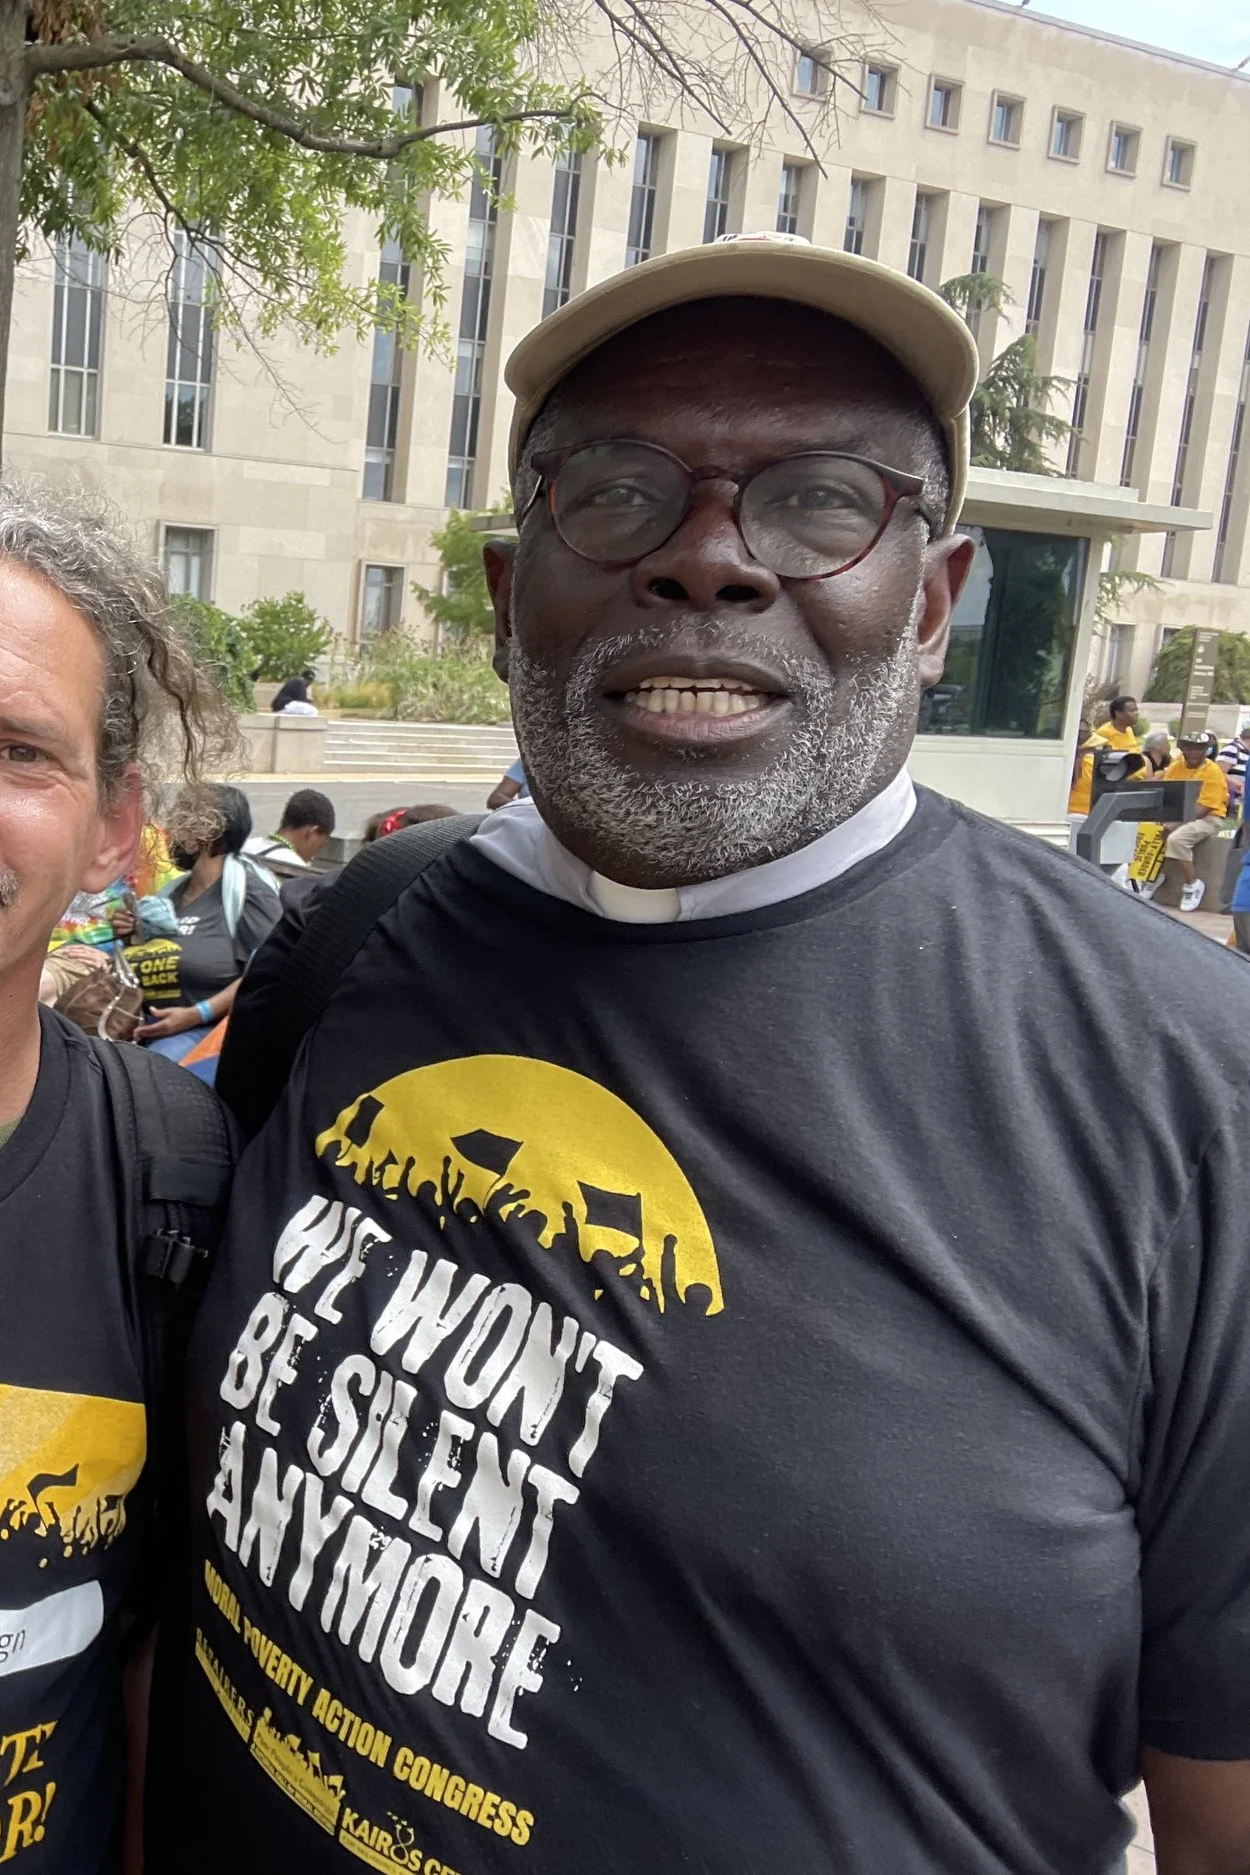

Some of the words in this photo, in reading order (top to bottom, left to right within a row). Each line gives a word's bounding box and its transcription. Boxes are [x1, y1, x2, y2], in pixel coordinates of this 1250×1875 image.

[140, 956, 181, 974] ONE
[220, 1291, 318, 1436] BE
[307, 1354, 581, 1599] SILENT
[272, 1195, 392, 1324] WE
[370, 1249, 644, 1478] WON'T
[206, 1421, 561, 1749] ANYMORE
[243, 1616, 314, 1706] POVERTY
[312, 1688, 392, 1767] ACTION
[393, 1747, 535, 1846] CONGRESS
